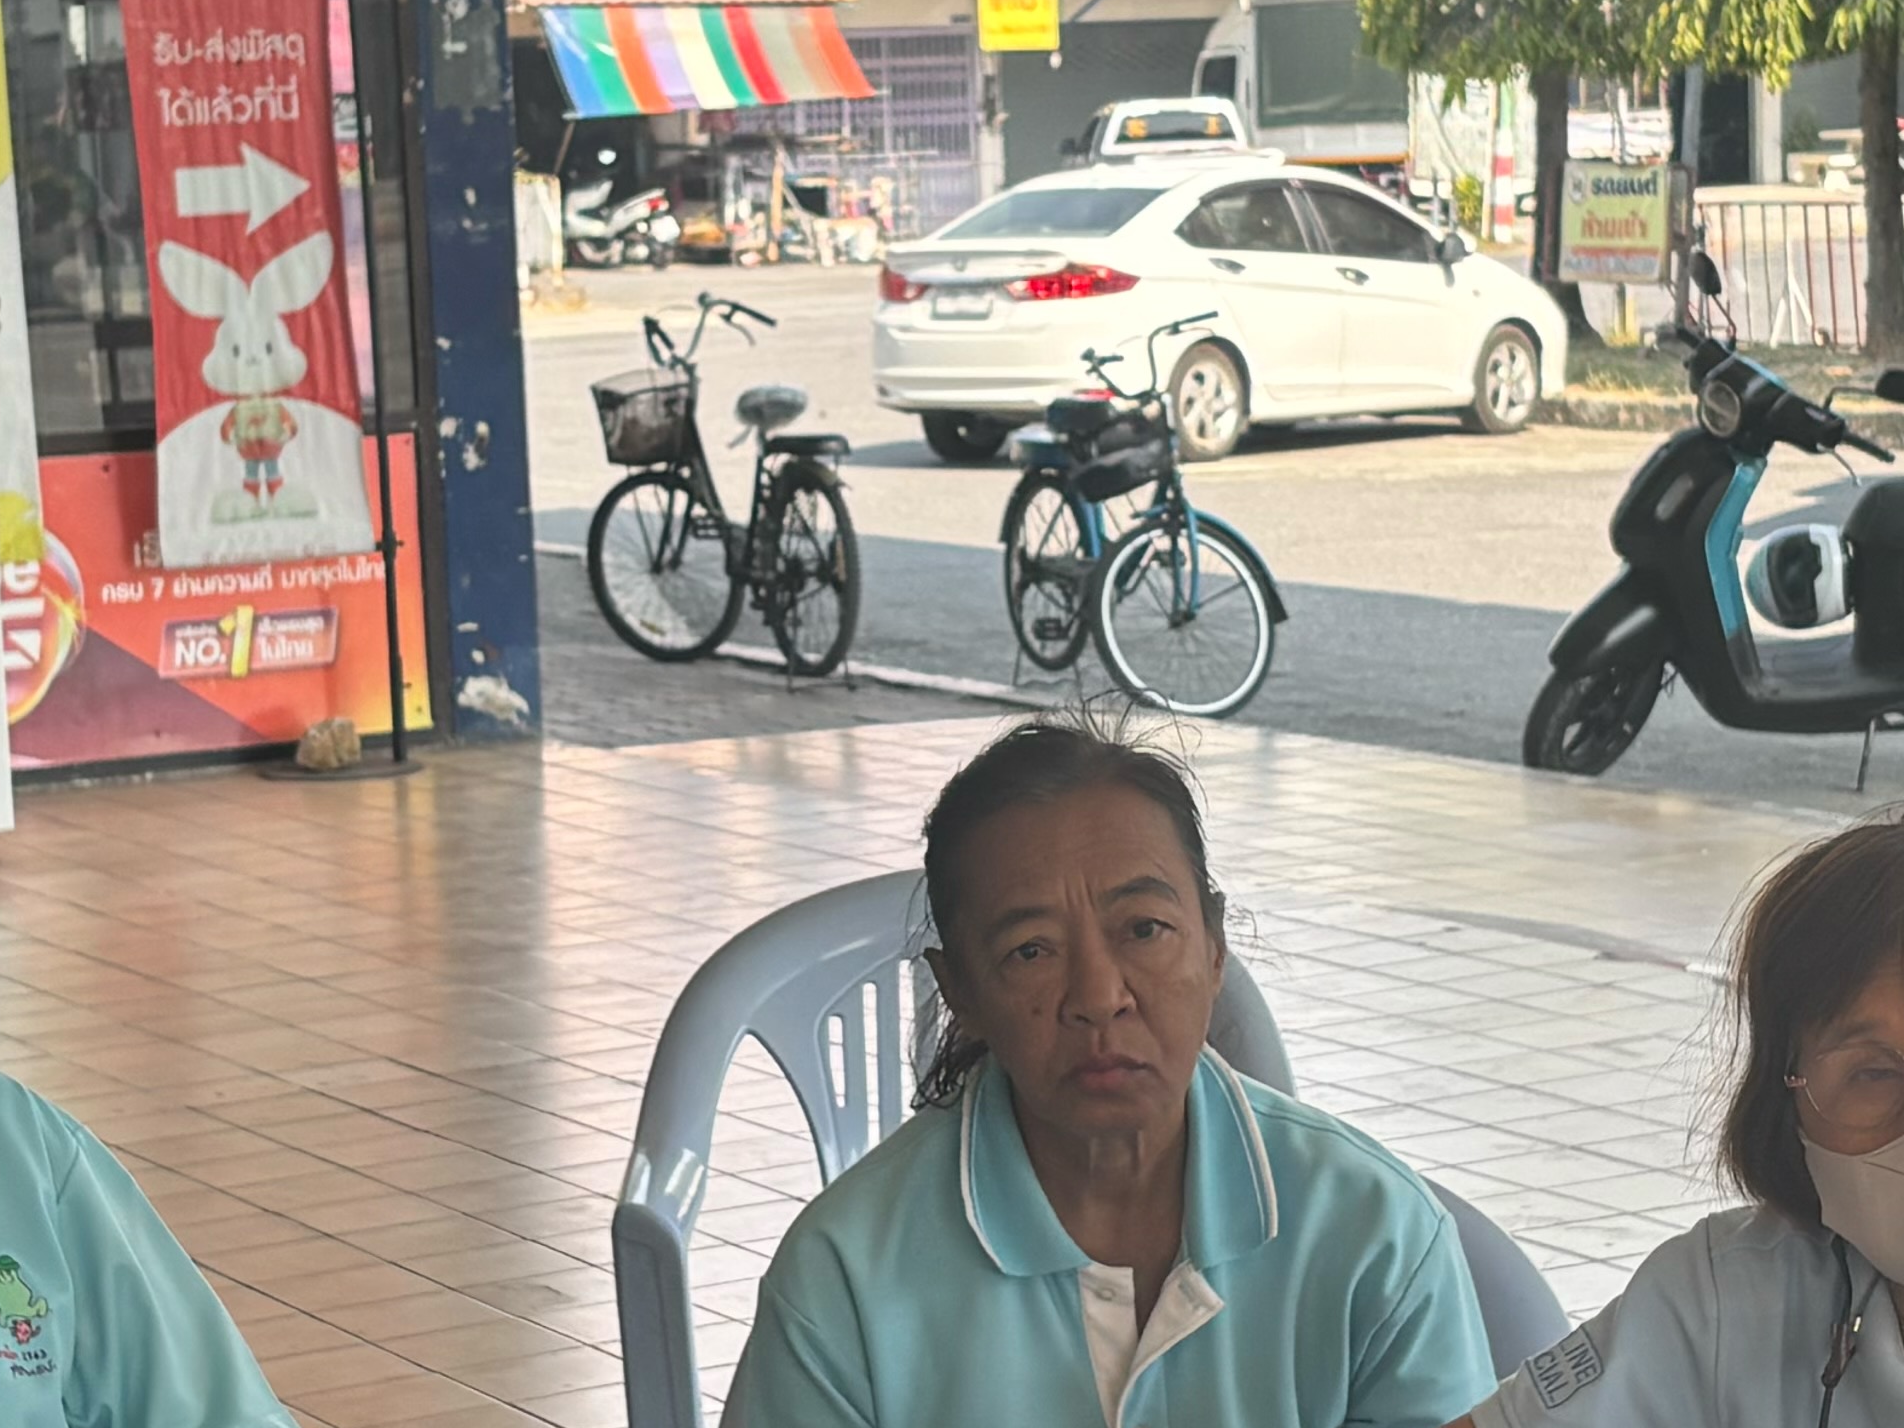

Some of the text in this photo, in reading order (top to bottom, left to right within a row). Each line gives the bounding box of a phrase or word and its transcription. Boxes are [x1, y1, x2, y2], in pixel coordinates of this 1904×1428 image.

[157, 74, 300, 128] ได้แล้วที่นี่
[152, 576, 165, 601] 7
